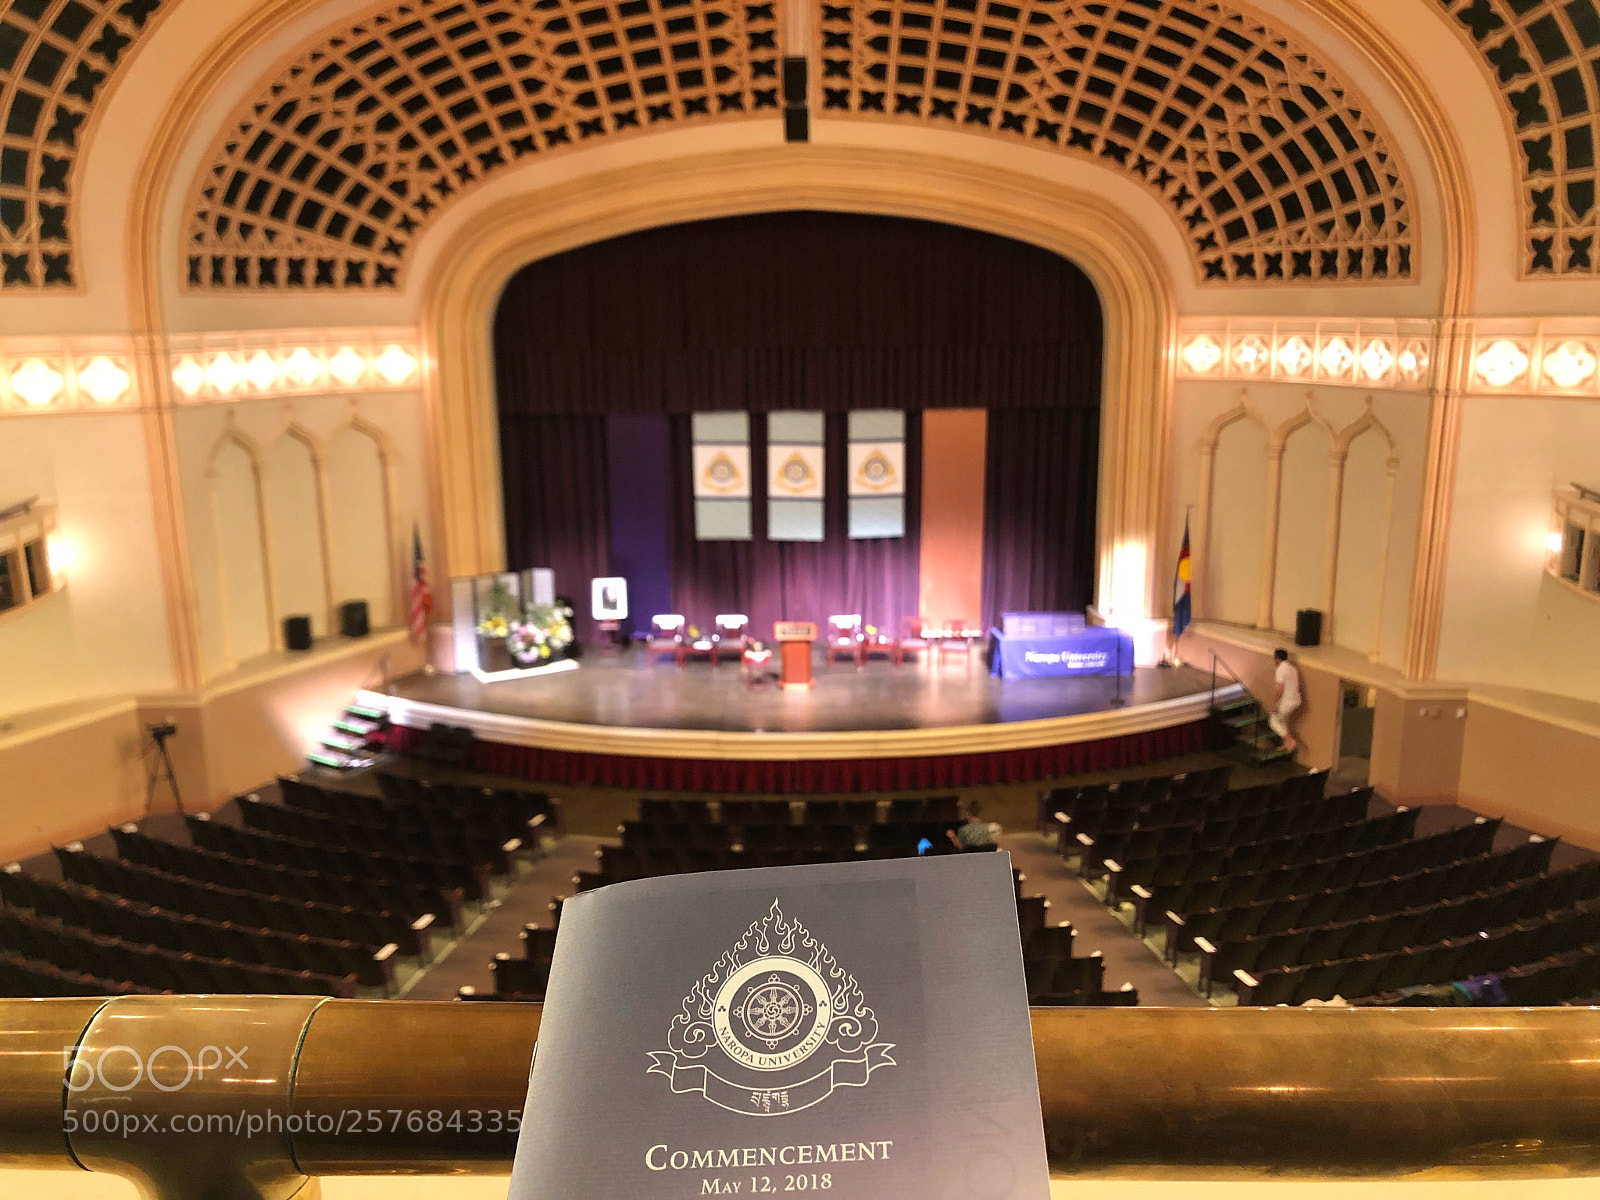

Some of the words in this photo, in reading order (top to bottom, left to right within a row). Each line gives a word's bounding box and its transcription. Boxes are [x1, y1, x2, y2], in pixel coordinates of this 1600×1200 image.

[718, 1026, 755, 1063] NAROPA
[758, 1021, 826, 1066] UNIVERSITY
[750, 1176, 778, 1194] 12,
[784, 1173, 833, 1192] 2018
